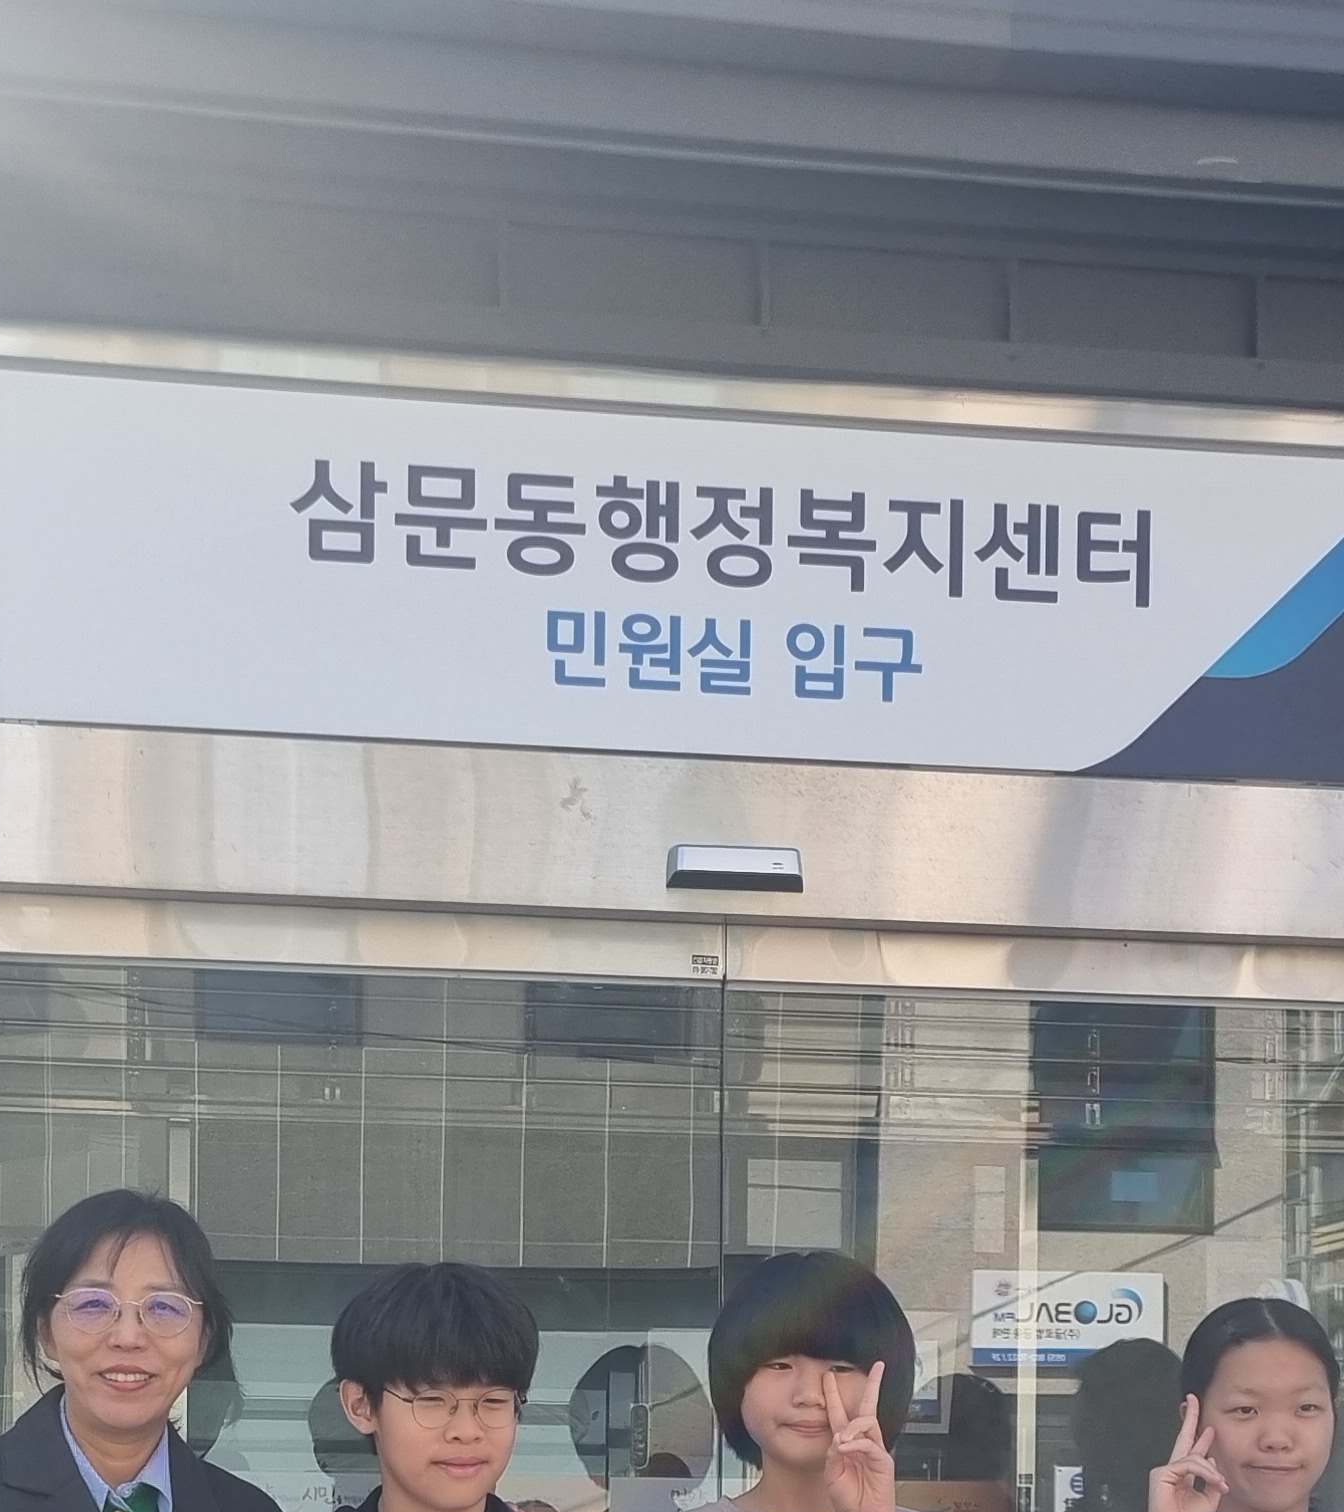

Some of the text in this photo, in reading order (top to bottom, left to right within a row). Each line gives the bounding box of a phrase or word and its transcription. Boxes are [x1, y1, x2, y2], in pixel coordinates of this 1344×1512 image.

[290, 459, 1153, 608] 삼문동행정복지센터
[546, 609, 924, 703] 민원실 입구
